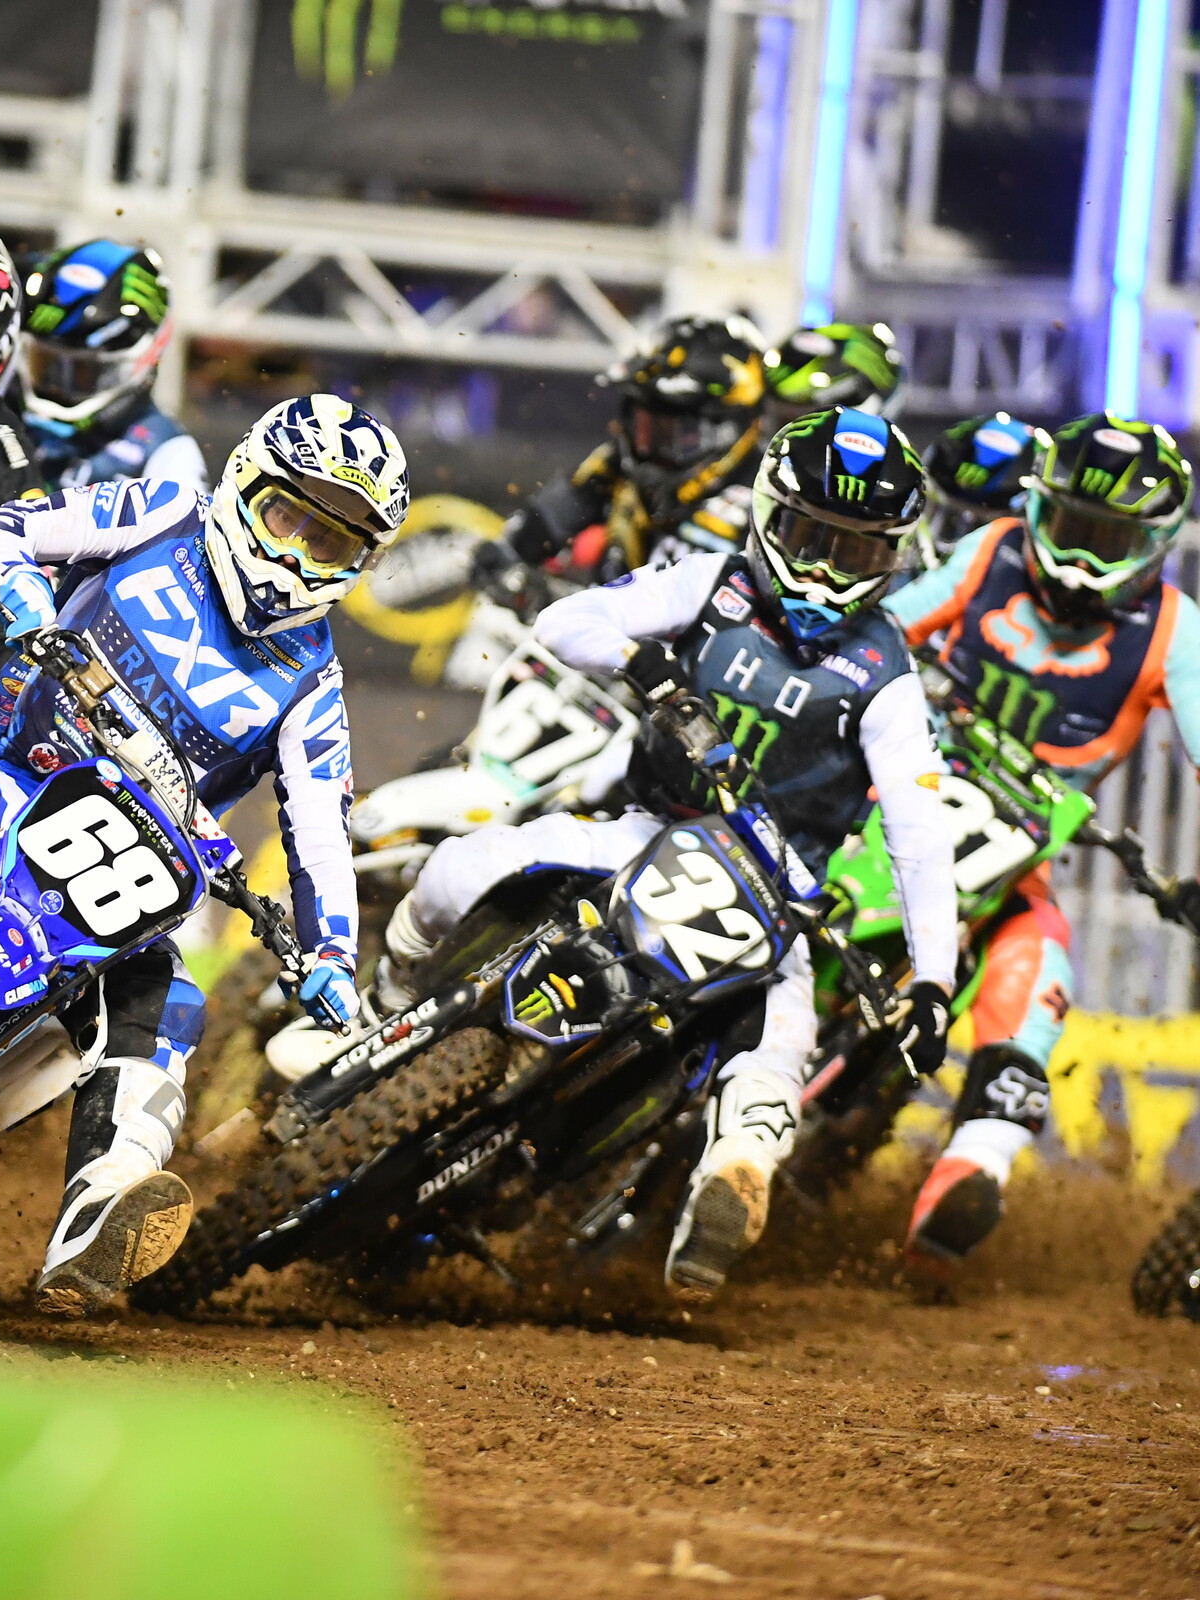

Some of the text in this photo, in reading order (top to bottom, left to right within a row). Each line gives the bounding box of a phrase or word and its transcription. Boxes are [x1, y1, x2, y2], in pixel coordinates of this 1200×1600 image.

[844, 436, 875, 451] BELL
[341, 469, 377, 496] SHOEI
[114, 564, 280, 741] FXR
[116, 645, 194, 740] RACE
[128, 799, 175, 855] MONSTER
[130, 812, 162, 849] ENERGY
[17, 794, 181, 937] 68
[630, 851, 772, 982] 32
[4, 978, 47, 1006] CLUBMX
[416, 1119, 520, 1204] DUNLOP
